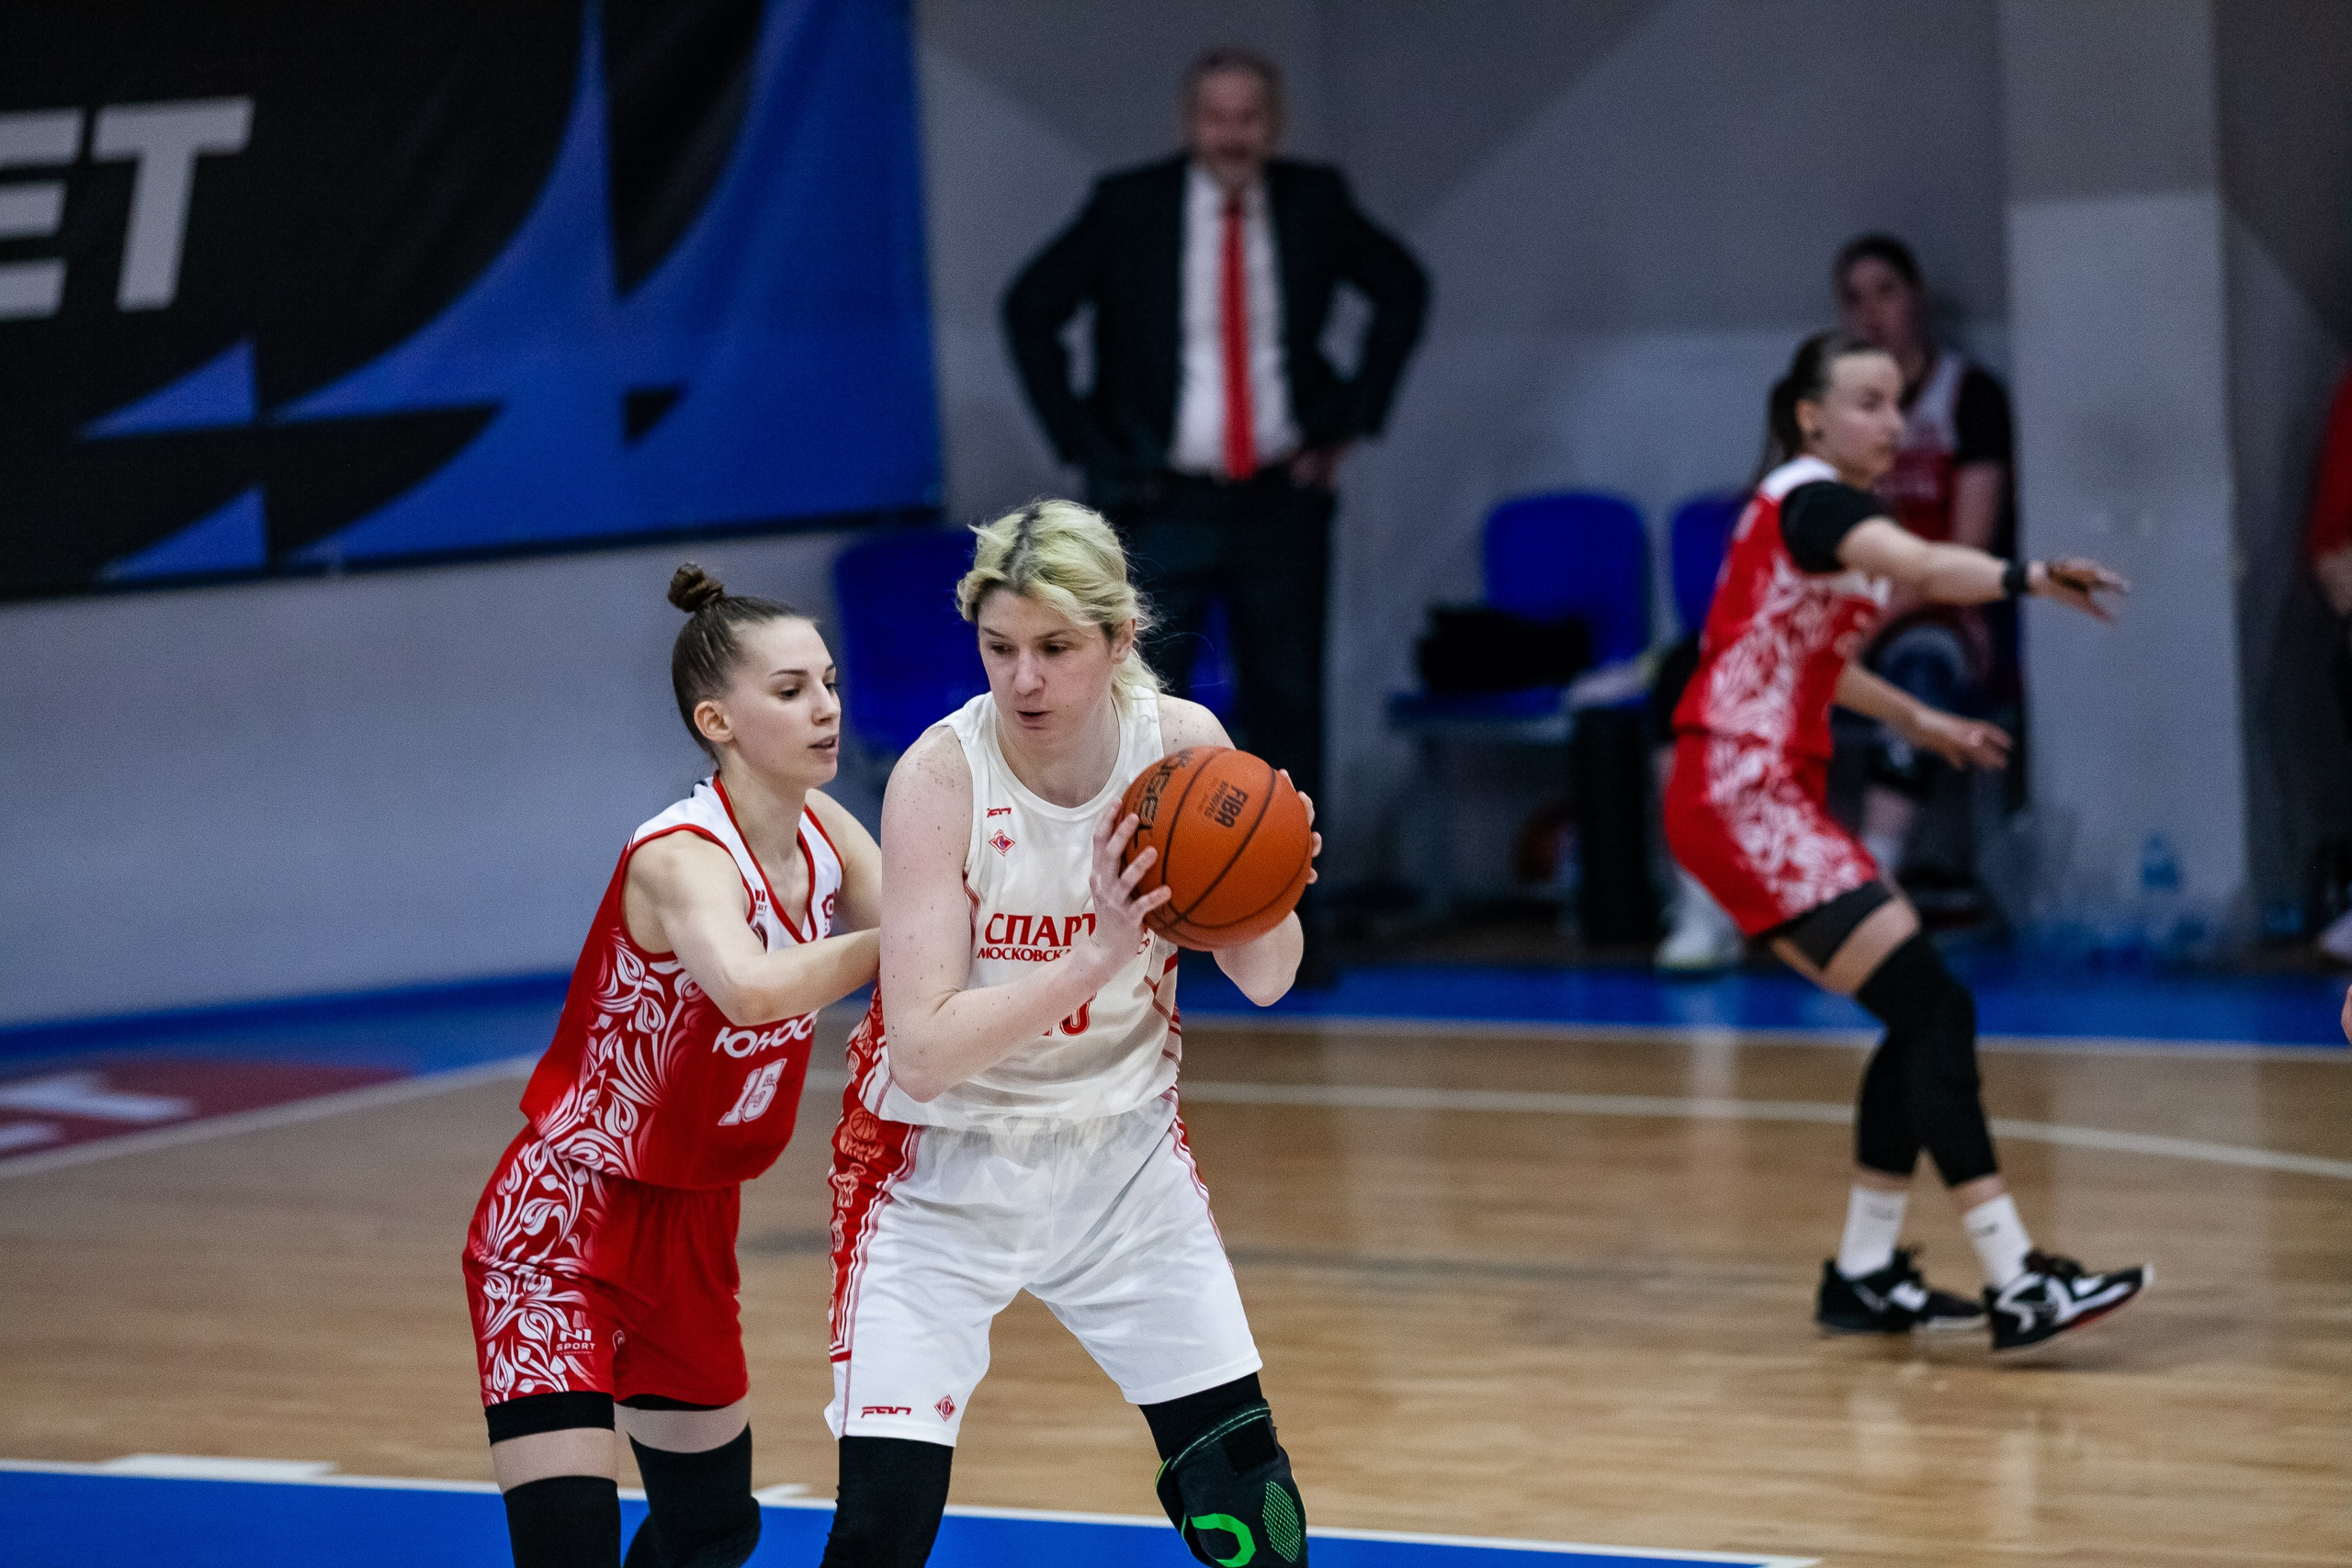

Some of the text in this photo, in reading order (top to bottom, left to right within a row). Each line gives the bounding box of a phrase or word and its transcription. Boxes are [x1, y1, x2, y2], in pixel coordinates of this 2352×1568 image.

[1214, 784, 1249, 828] FIBA
[977, 947, 1071, 962] МОСКОВСК
[712, 1009, 818, 1059] ЮНОС
[718, 1058, 787, 1126] 15
[556, 1342, 595, 1351] SPORT
